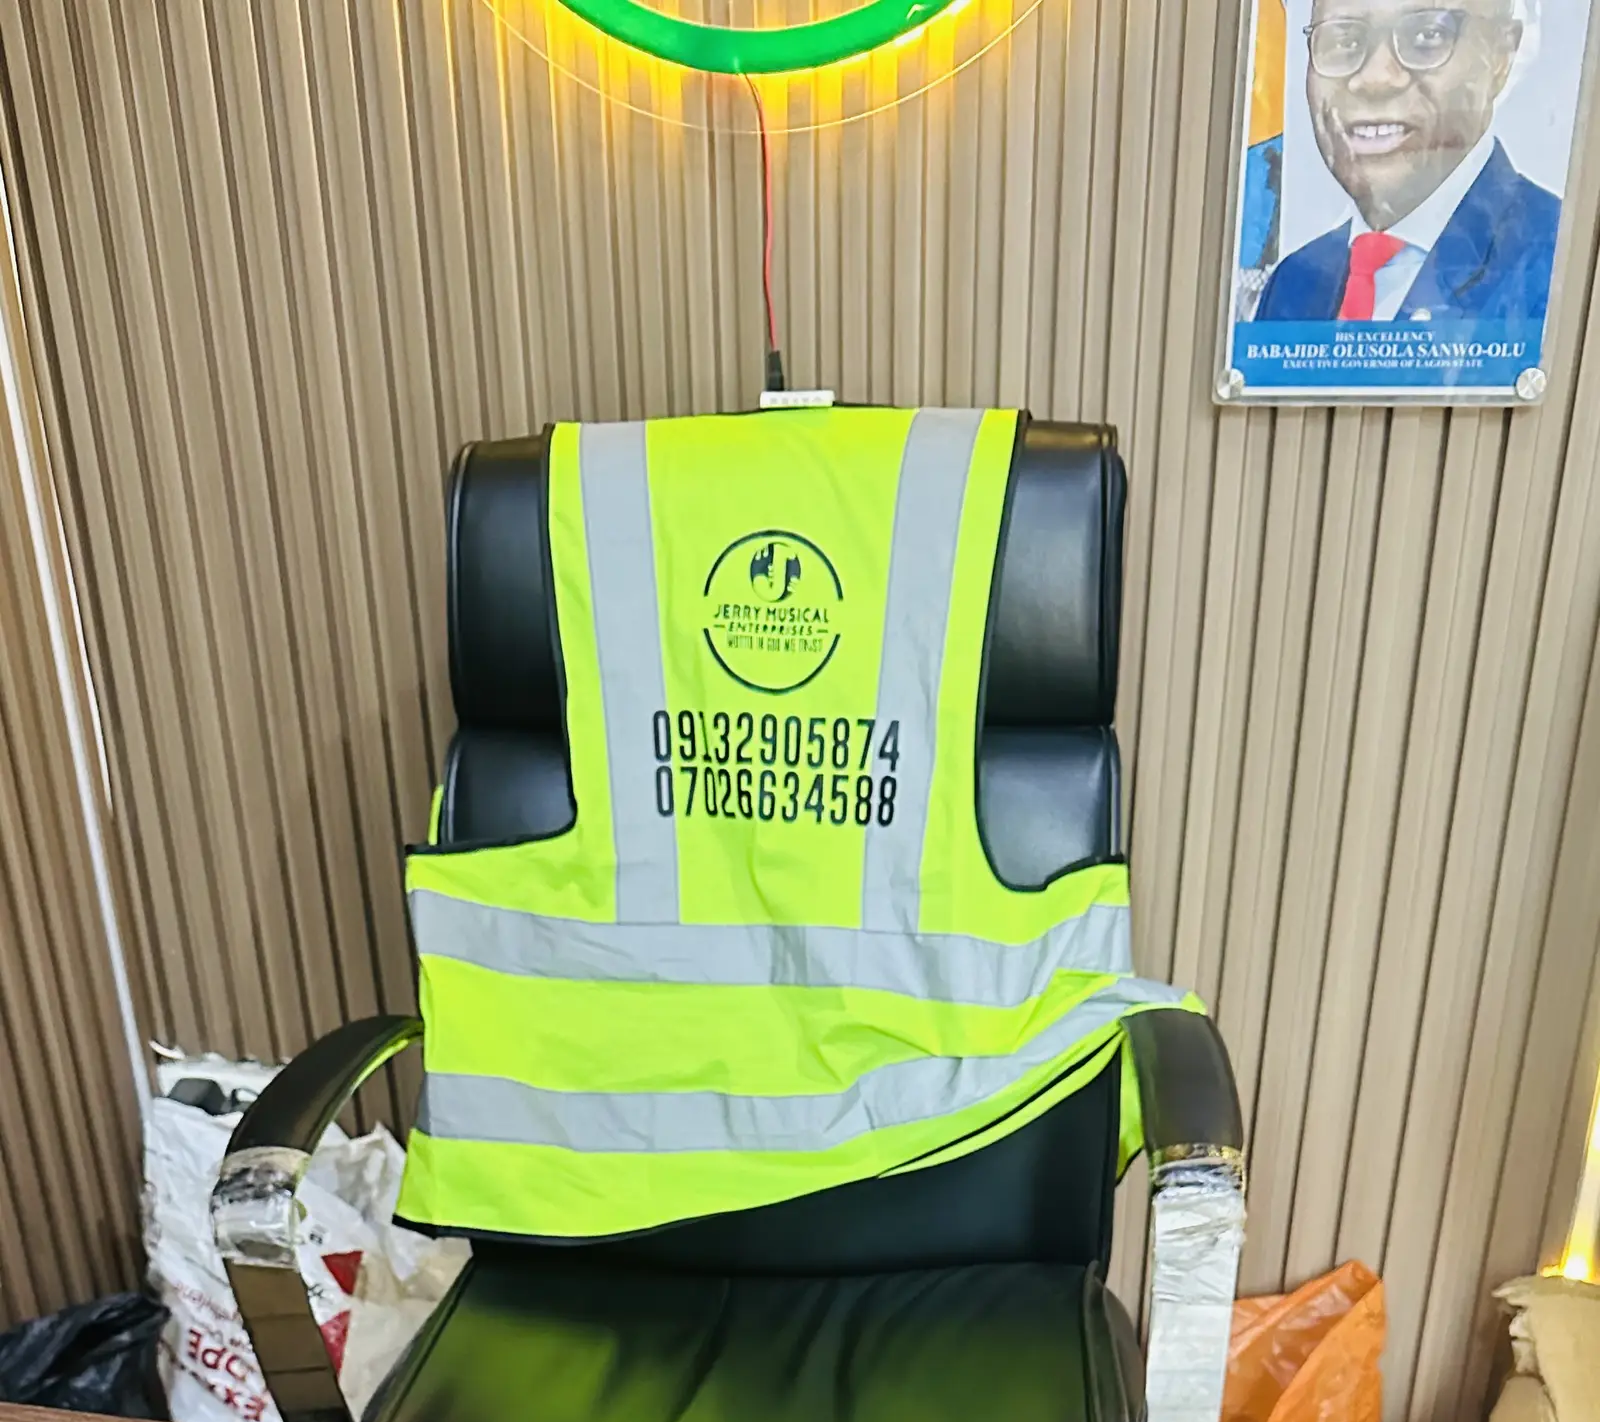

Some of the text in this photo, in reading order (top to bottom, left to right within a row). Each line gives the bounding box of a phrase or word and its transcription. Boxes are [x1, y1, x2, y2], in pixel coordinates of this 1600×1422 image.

[1335, 332, 1433, 342] HIS EXCELLENCY
[1247, 342, 1527, 359] BABAJIDE OLUSOLA SANWO-OLU
[714, 603, 829, 624] JERRY MUSICAL
[653, 709, 900, 772] 09132905874
[655, 765, 898, 827] 07026634588
